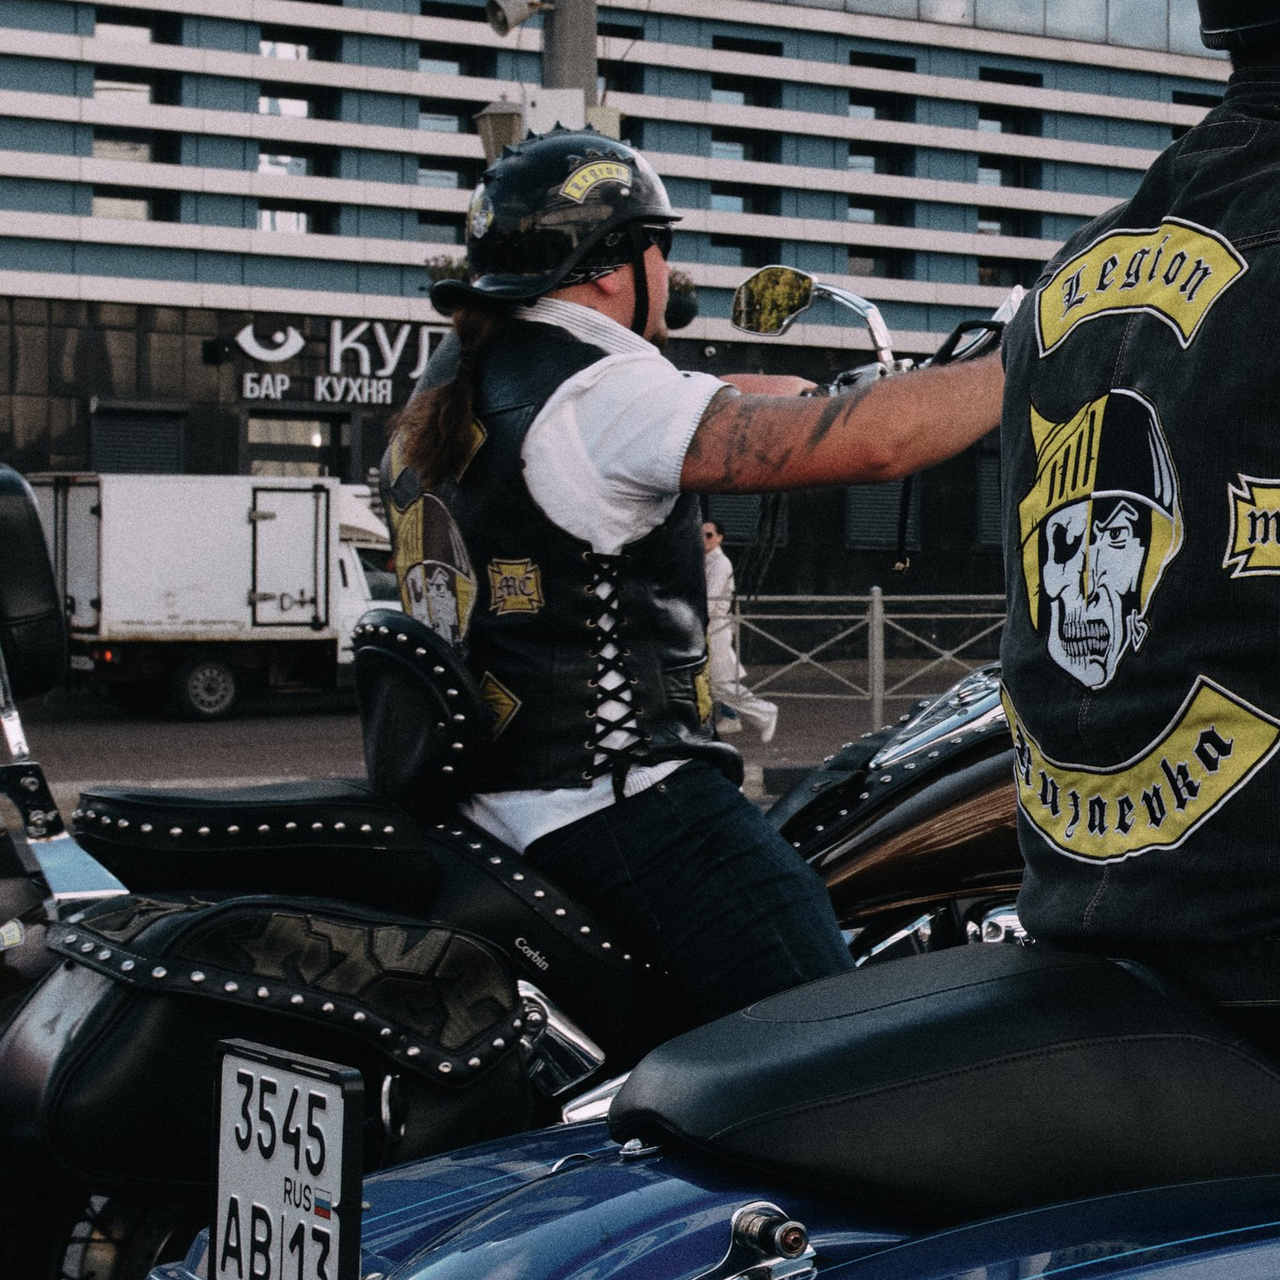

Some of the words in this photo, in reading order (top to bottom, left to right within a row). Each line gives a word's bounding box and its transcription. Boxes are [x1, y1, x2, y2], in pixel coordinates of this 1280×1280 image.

[571, 164, 622, 191] Legion
[1060, 234, 1212, 320] Legion
[242, 372, 290, 400] БАР
[314, 375, 393, 404] КУХНЯ
[515, 937, 550, 971] Corbin
[235, 1069, 327, 1177] 3545
[284, 1176, 312, 1213] RUS
